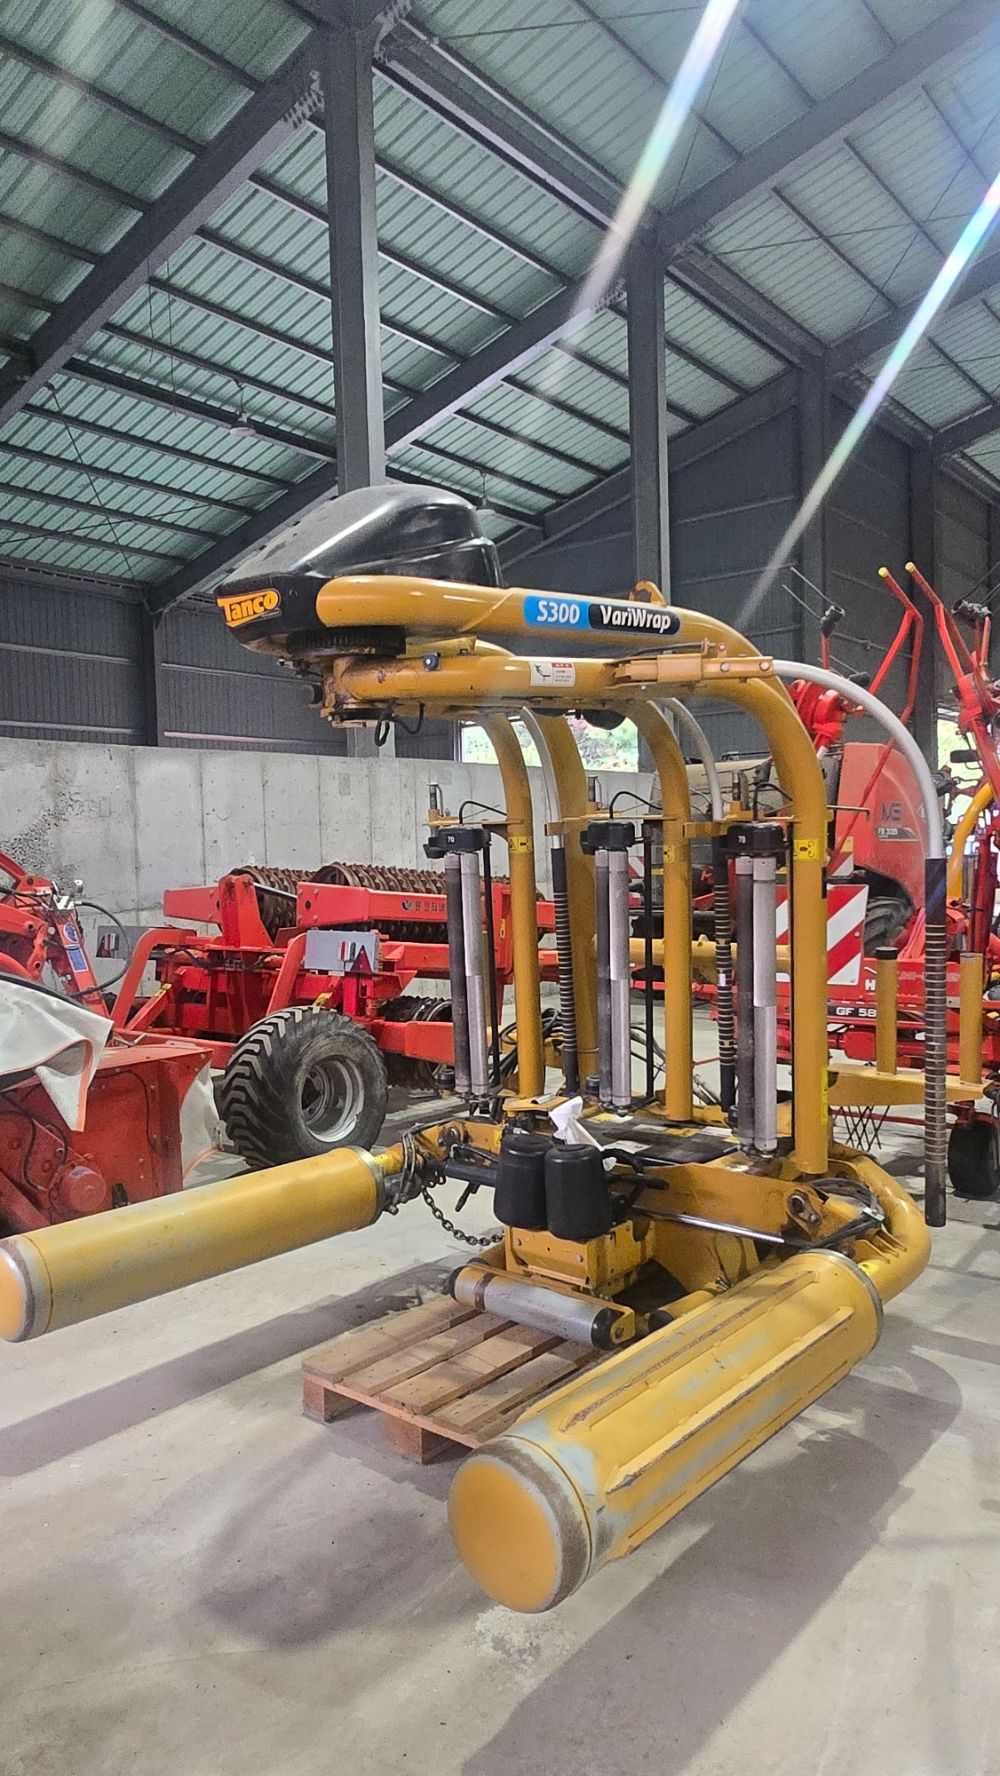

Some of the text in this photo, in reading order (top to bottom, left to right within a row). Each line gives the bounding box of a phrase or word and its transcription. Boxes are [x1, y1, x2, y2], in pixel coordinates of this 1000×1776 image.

[217, 591, 279, 622] Tanco
[537, 600, 671, 634] S300 VariWrap
[836, 1006, 877, 1017] GF 58
